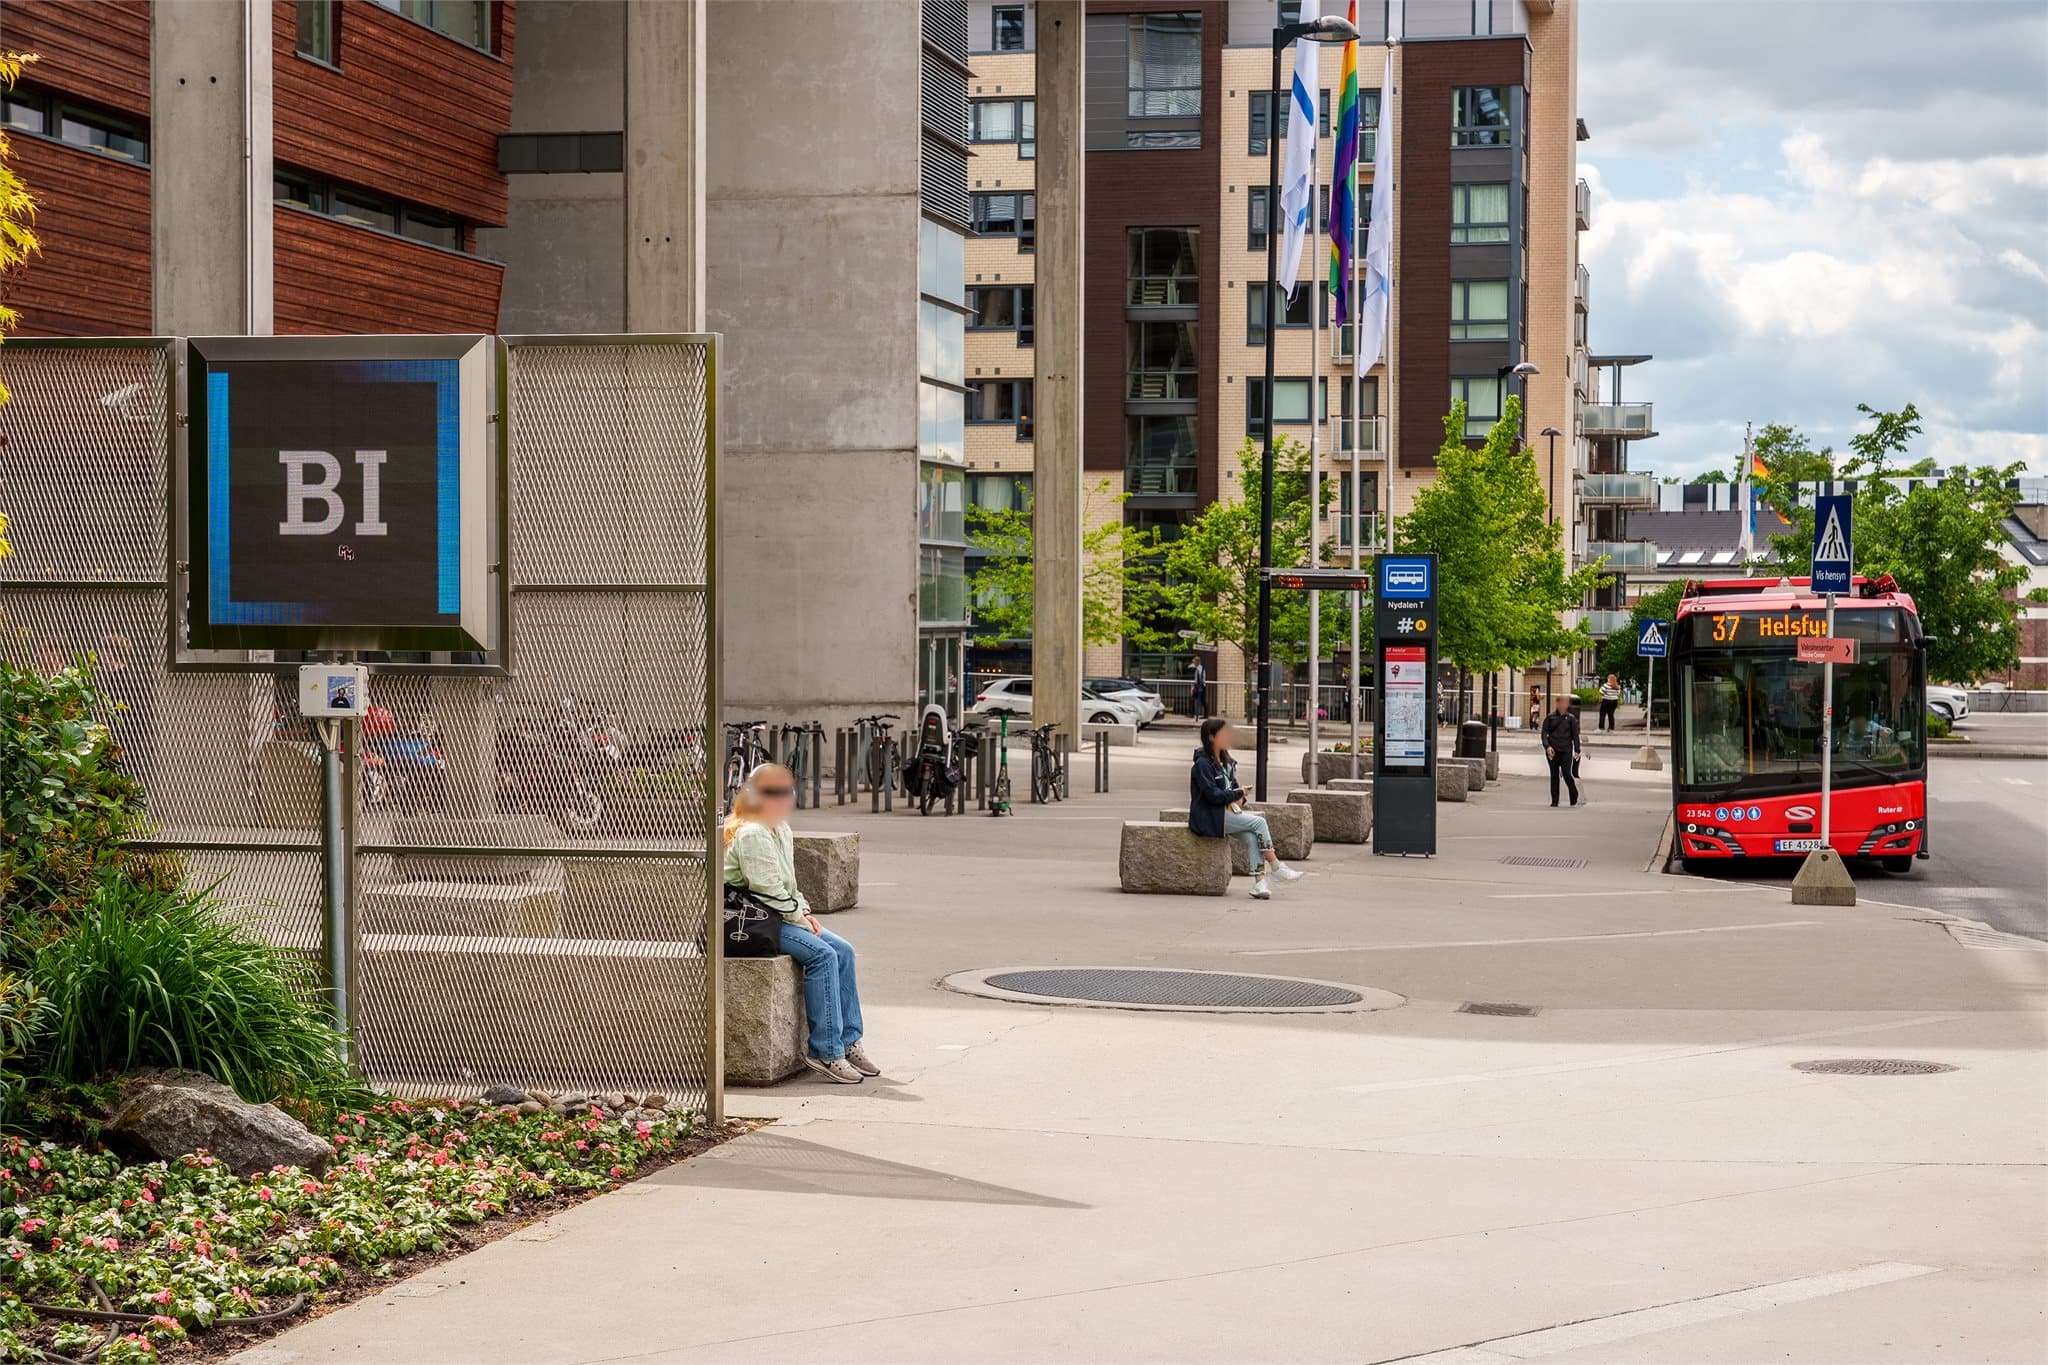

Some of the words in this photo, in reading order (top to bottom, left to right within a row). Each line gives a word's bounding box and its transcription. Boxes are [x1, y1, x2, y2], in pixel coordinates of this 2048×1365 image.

[278, 449, 388, 536] BI
[1815, 569, 1824, 580] Vis
[1825, 569, 1846, 582] hensyn
[1388, 601, 1418, 610] Nydalen
[1712, 615, 1740, 641] 37
[1686, 809, 1696, 818] 23
[1697, 809, 1712, 818] 542
[1878, 806, 1896, 814] Ruter
